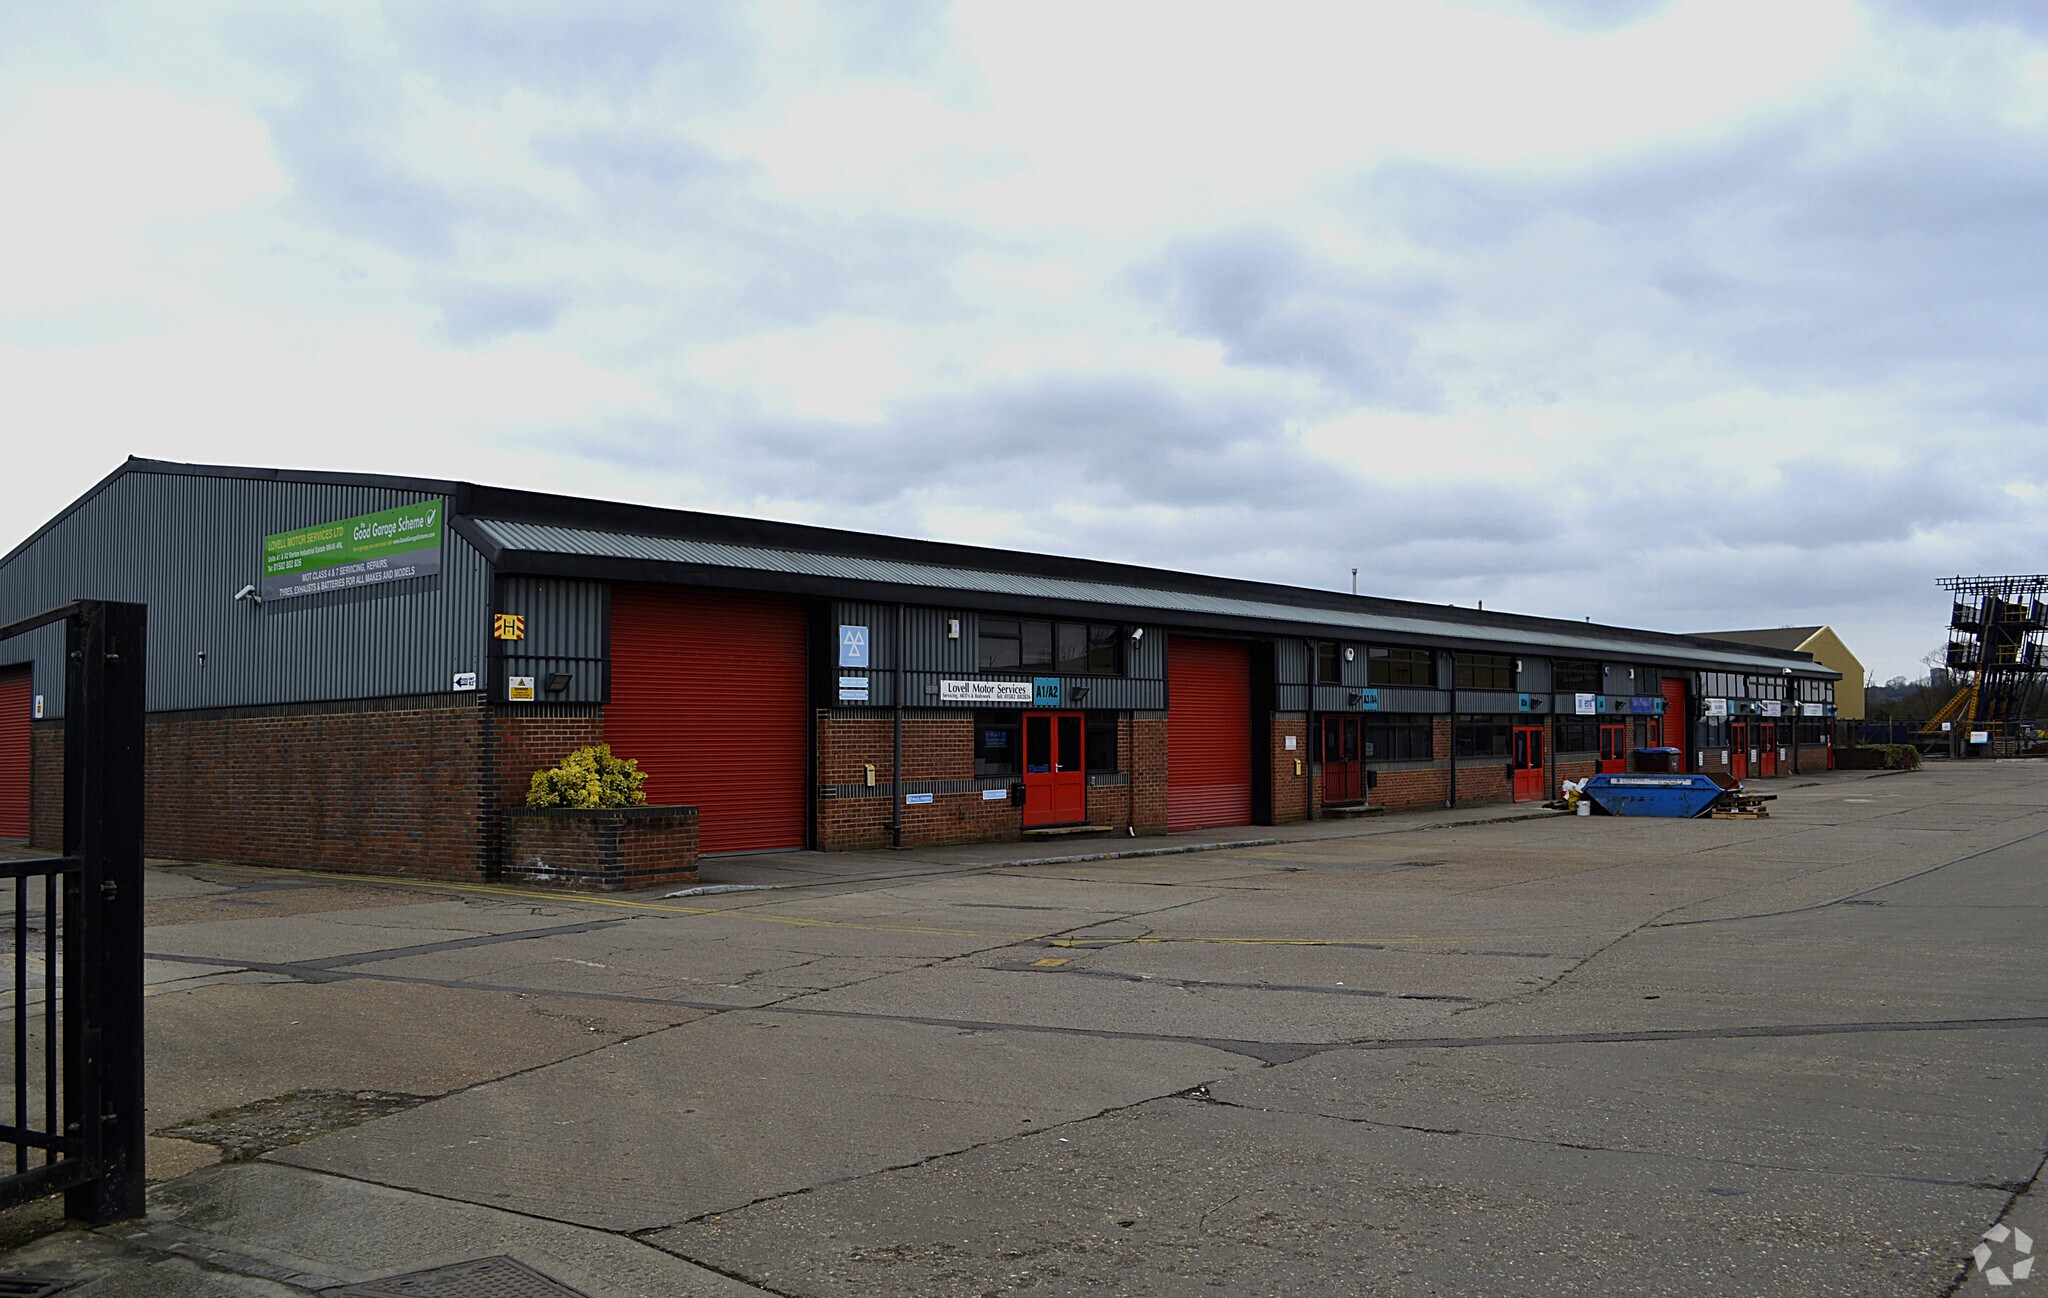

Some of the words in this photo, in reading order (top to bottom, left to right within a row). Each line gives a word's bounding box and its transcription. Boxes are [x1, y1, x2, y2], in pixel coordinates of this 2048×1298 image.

[354, 523, 371, 541] Good
[372, 522, 396, 538] Garage
[398, 516, 424, 532] Scheme
[268, 539, 286, 551] LOVELL
[288, 534, 306, 547] MOTOR
[307, 529, 333, 543] SERVICES
[334, 527, 343, 538] LTD
[294, 583, 316, 594] EXHAUSTS
[321, 577, 344, 590] BATTERIES
[346, 576, 355, 586] FOR
[356, 574, 364, 584] ALL
[365, 571, 381, 582] MAKES
[383, 569, 393, 579] AND
[394, 566, 415, 577] MODELS
[302, 572, 312, 582] MOT
[313, 570, 327, 580] CLASS
[504, 618, 515, 635] H
[948, 682, 970, 693] Lovell
[972, 683, 995, 694] Motor
[998, 684, 1026, 695] Services
[1036, 685, 1058, 698] A1/A2
